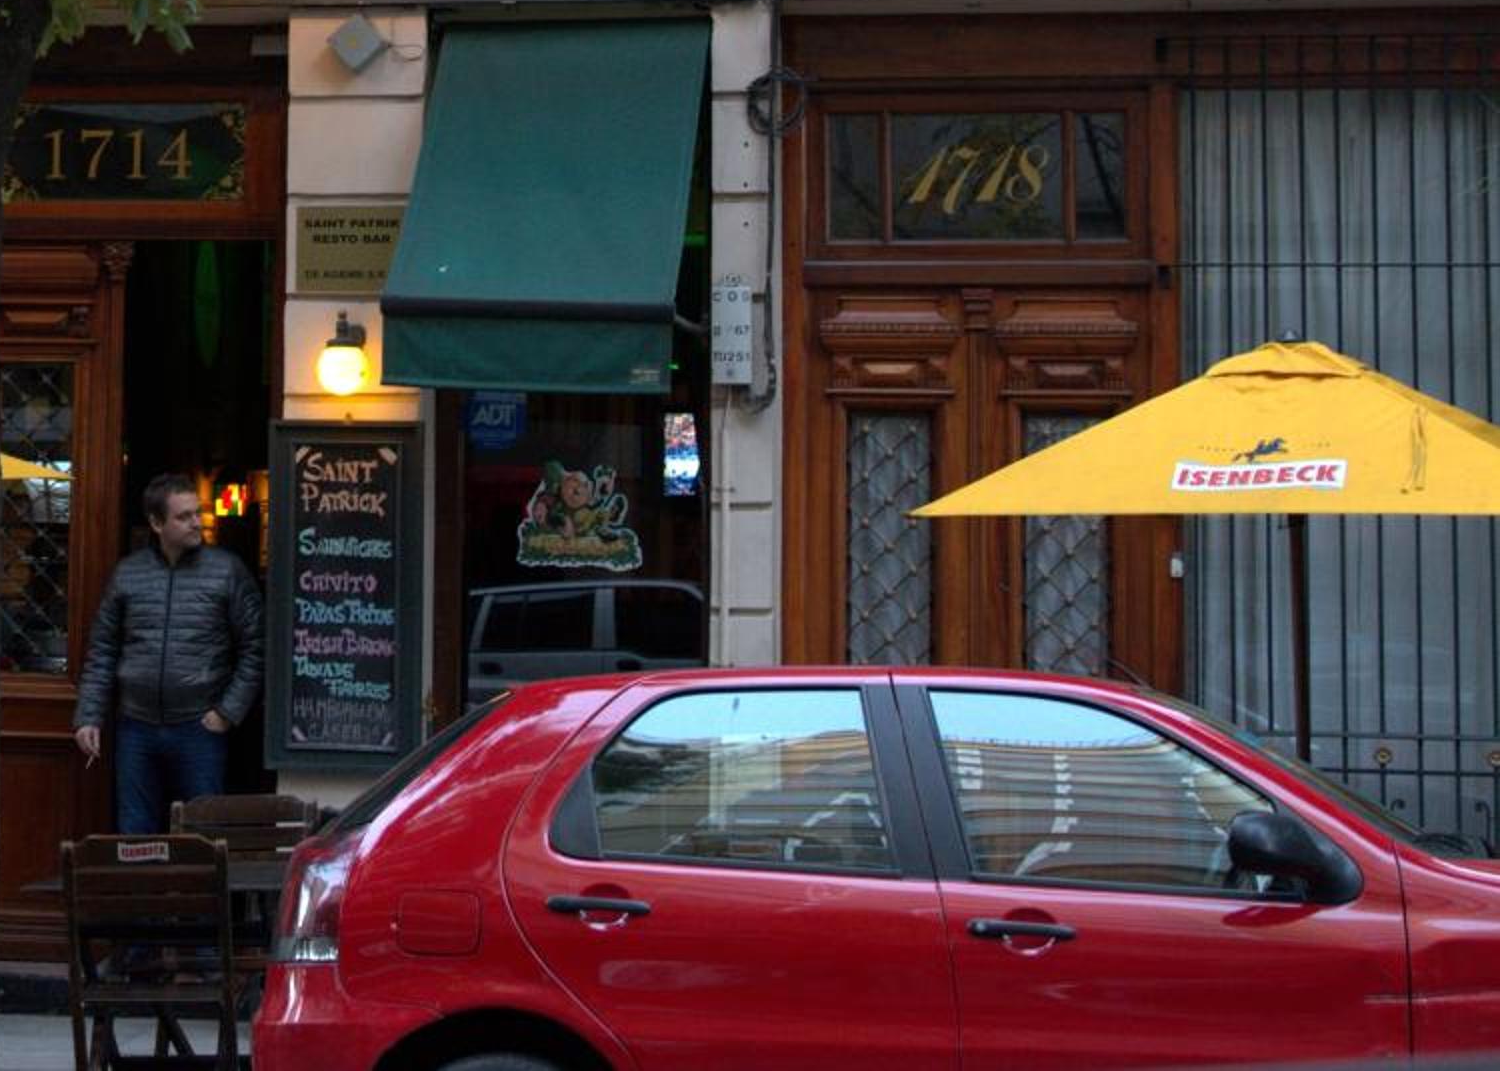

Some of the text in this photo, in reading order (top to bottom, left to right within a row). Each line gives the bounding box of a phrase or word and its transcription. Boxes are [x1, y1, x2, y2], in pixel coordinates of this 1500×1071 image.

[44, 128, 193, 179] 1714
[907, 144, 1050, 215] 1718
[471, 404, 516, 426] ADT
[303, 451, 378, 484] SAINT
[1177, 464, 1339, 487] ISENBECK
[300, 482, 388, 517] PATRICK
